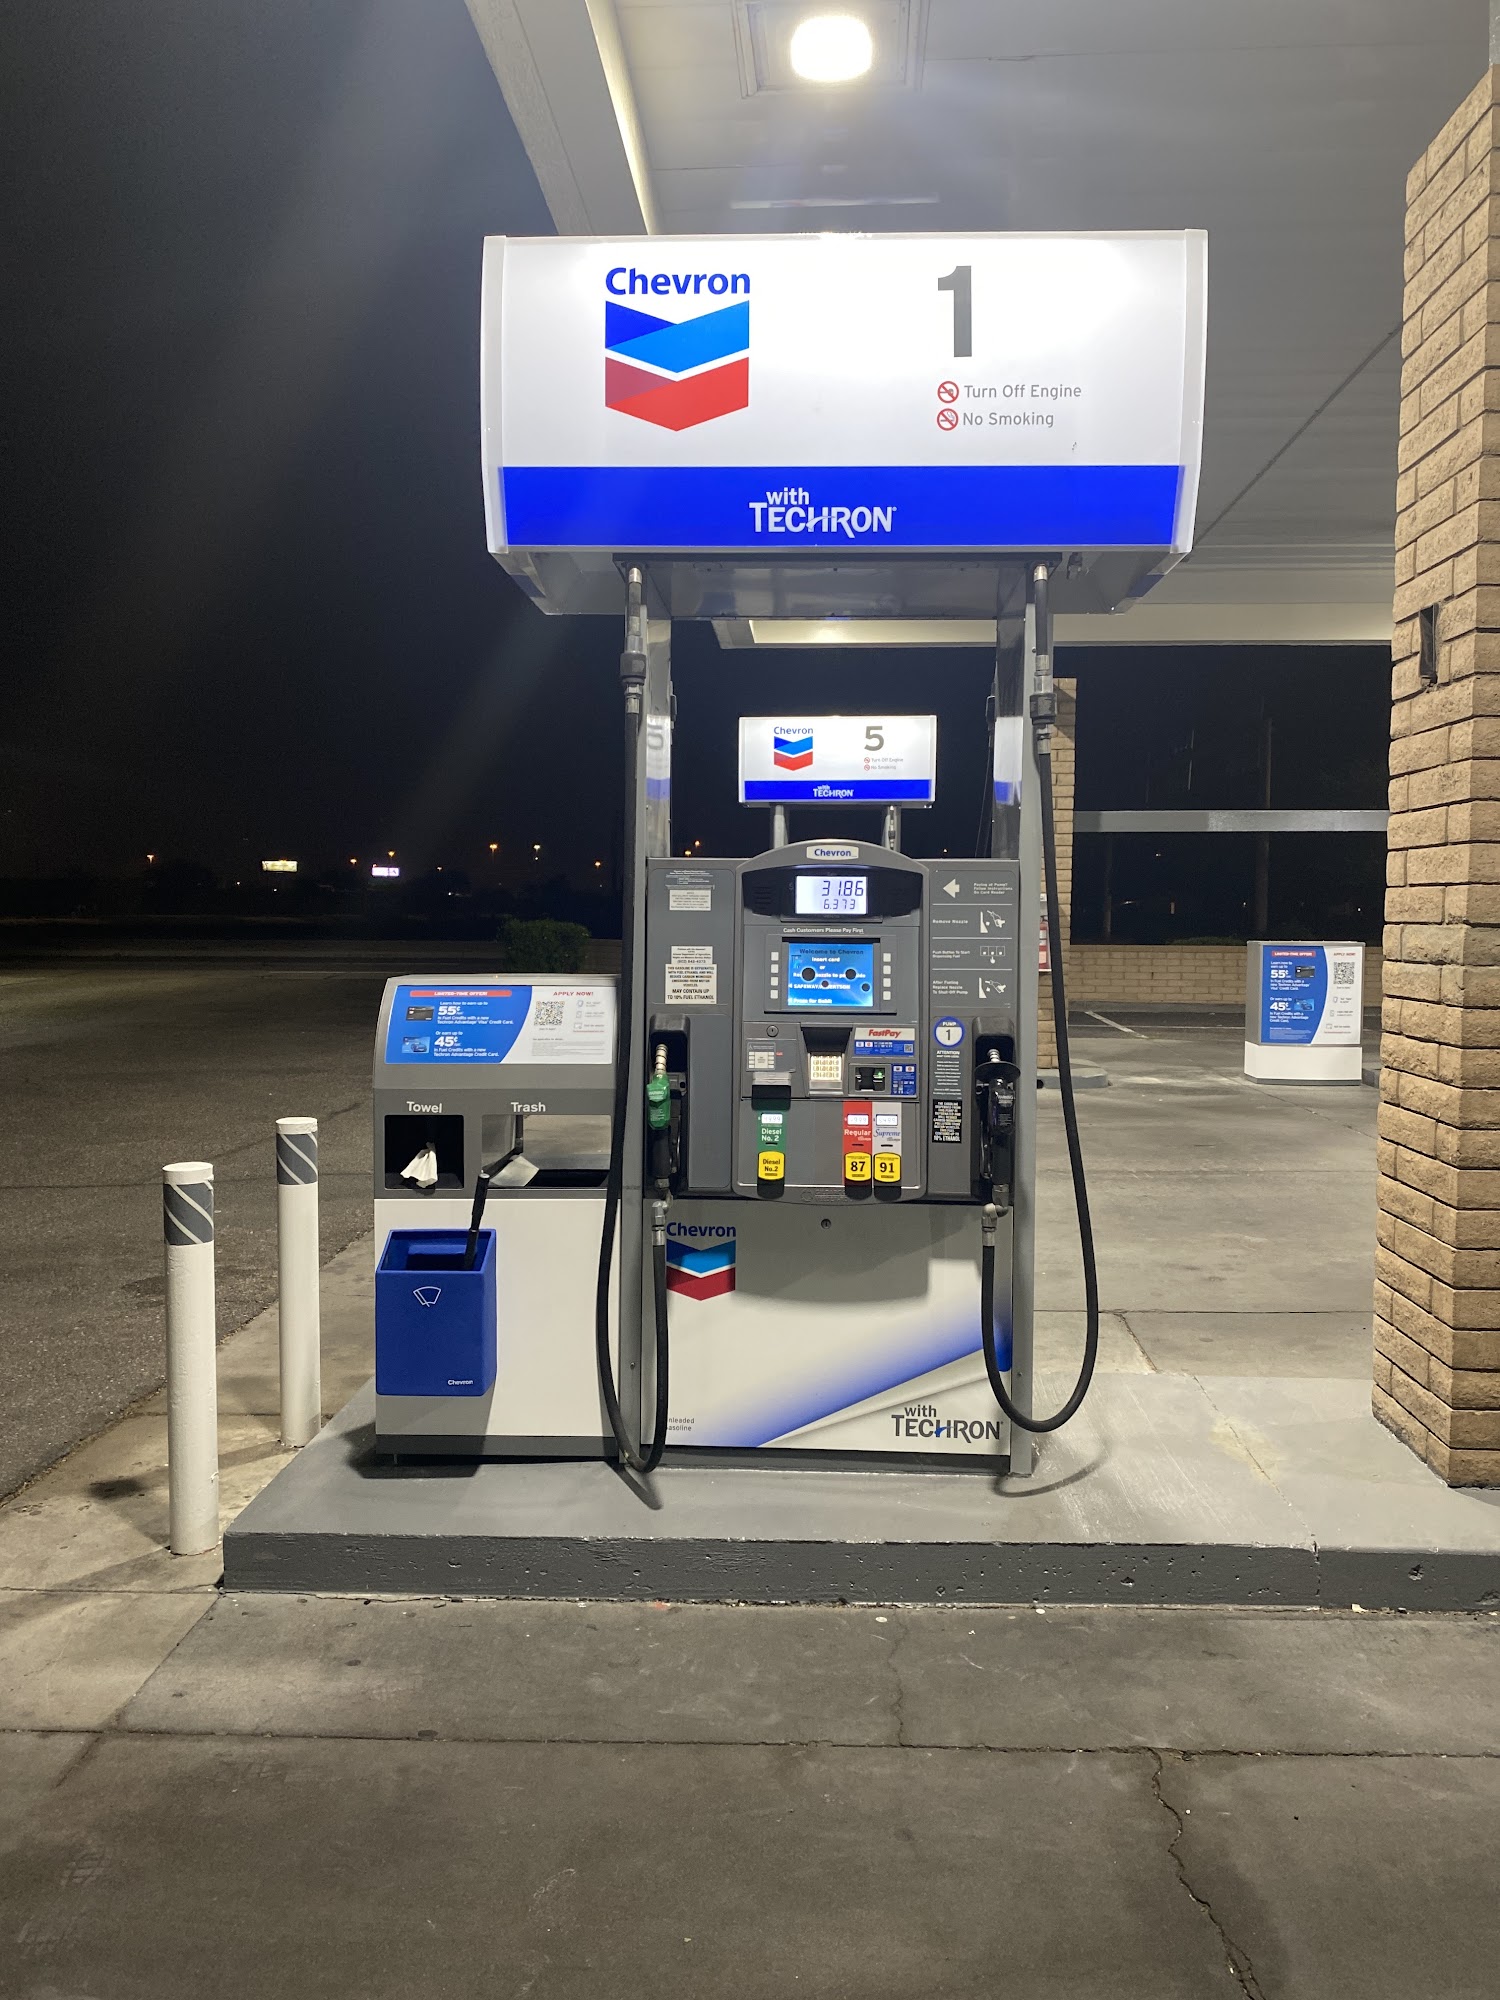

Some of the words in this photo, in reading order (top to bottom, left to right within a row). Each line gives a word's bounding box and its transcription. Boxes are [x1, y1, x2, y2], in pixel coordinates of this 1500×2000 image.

[605, 267, 750, 295] Chevron
[938, 265, 972, 357] 1
[964, 385, 997, 398] Turn
[1002, 384, 1025, 398] Off
[1030, 384, 1082, 400] Engine
[963, 412, 983, 426] No
[988, 412, 1054, 428] Smoking
[766, 487, 810, 505] with
[773, 726, 813, 735] Chevron
[864, 726, 884, 751] 5
[814, 848, 851, 857] Chevron
[823, 899, 856, 910] 6.373
[868, 1029, 901, 1038] FastPay
[945, 1029, 951, 1040] 1
[406, 1101, 442, 1113] Towel
[511, 1102, 546, 1112] Trash
[873, 1129, 900, 1137] Supreme
[850, 1161, 865, 1172] 87
[880, 1162, 894, 1173] 91
[666, 1222, 736, 1237] Chevron
[904, 1400, 937, 1417] with
